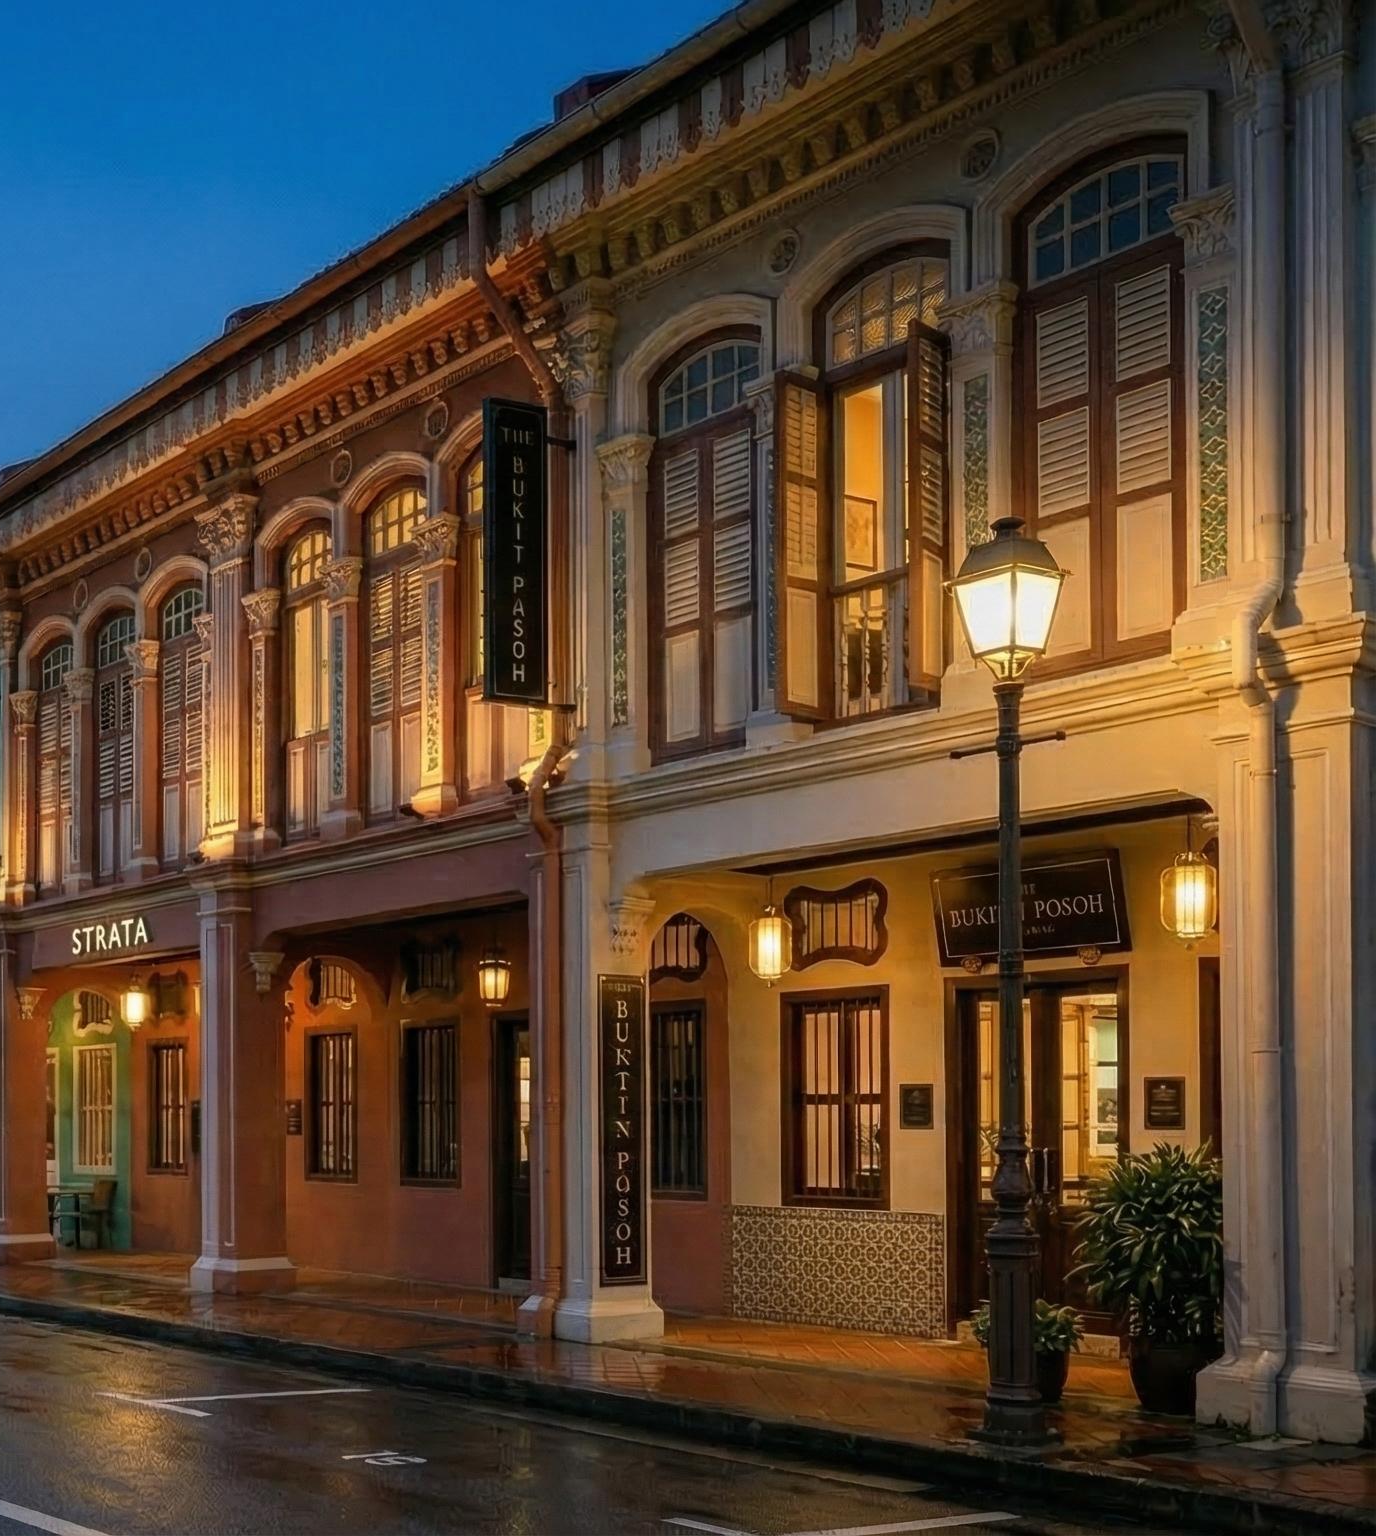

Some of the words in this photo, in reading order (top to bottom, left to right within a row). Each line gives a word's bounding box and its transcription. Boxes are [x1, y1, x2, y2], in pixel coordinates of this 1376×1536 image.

[512, 456, 526, 564] BUKIT
[512, 576, 526, 683] PASOH
[72, 917, 148, 955] STRATA
[1034, 893, 1104, 919] POSOH
[616, 1151, 632, 1265] POSOH
